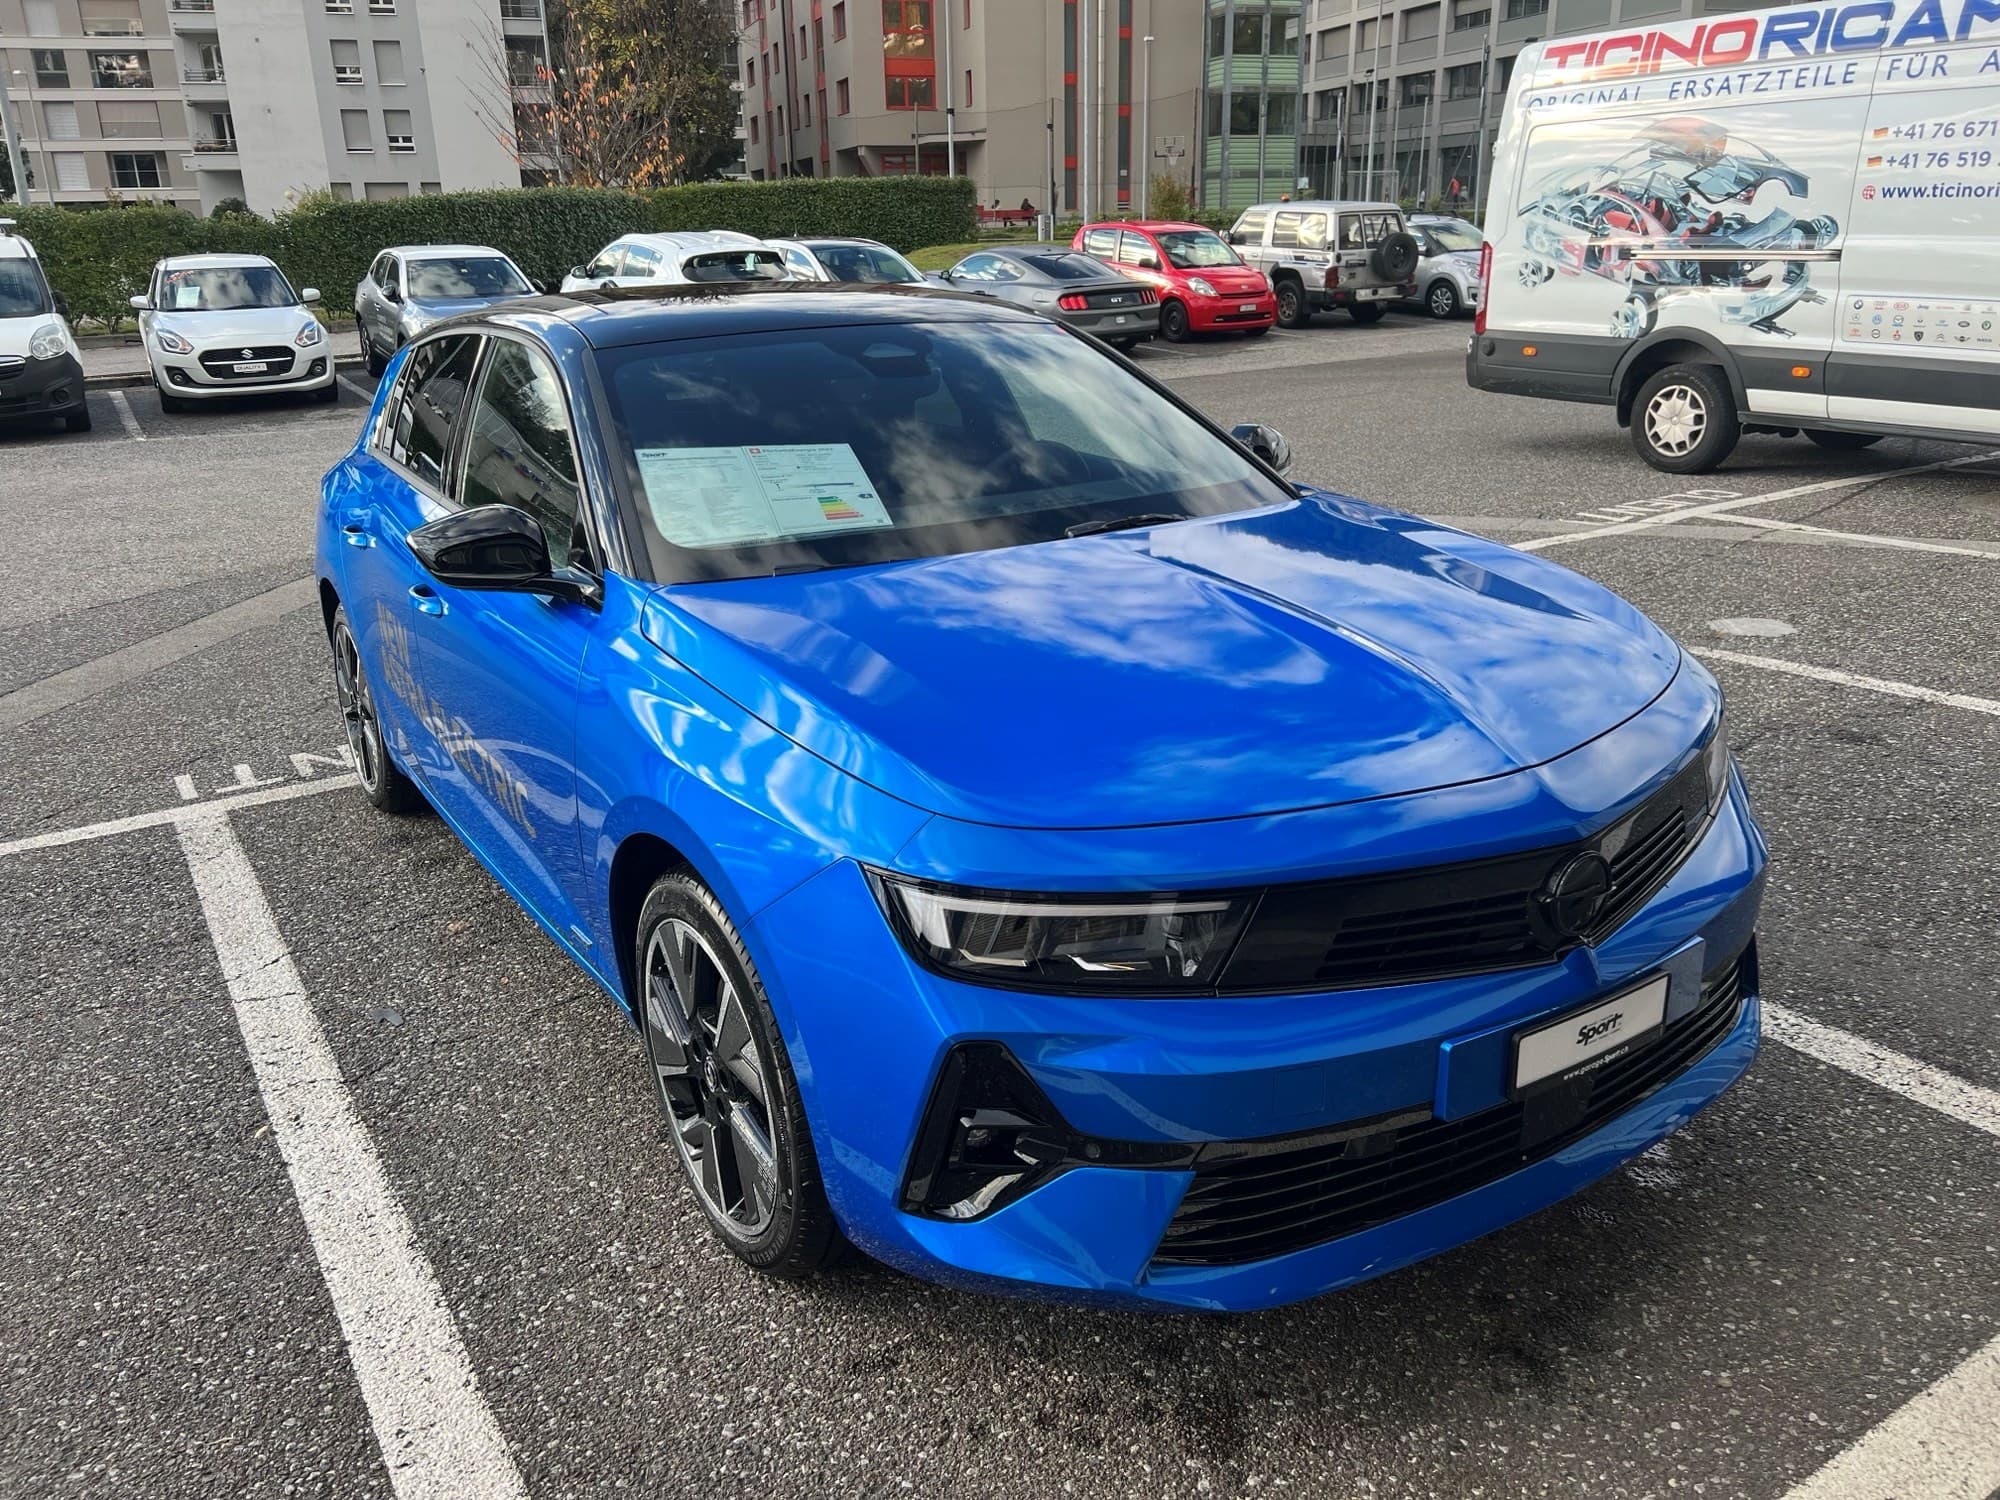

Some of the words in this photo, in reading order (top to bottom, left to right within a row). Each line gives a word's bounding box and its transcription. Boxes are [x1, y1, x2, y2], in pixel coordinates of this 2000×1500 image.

[1668, 62, 1859, 100] ERSATZTEILE
[1886, 53, 1949, 81] FÜR
[1892, 123, 1925, 139] +41
[1932, 122, 1956, 139] 76
[1963, 120, 1998, 138] 671
[1886, 152, 1919, 169] +41
[1925, 152, 1949, 169] 76
[1956, 151, 1992, 168] 519
[1575, 1013, 1624, 1046] Sport
